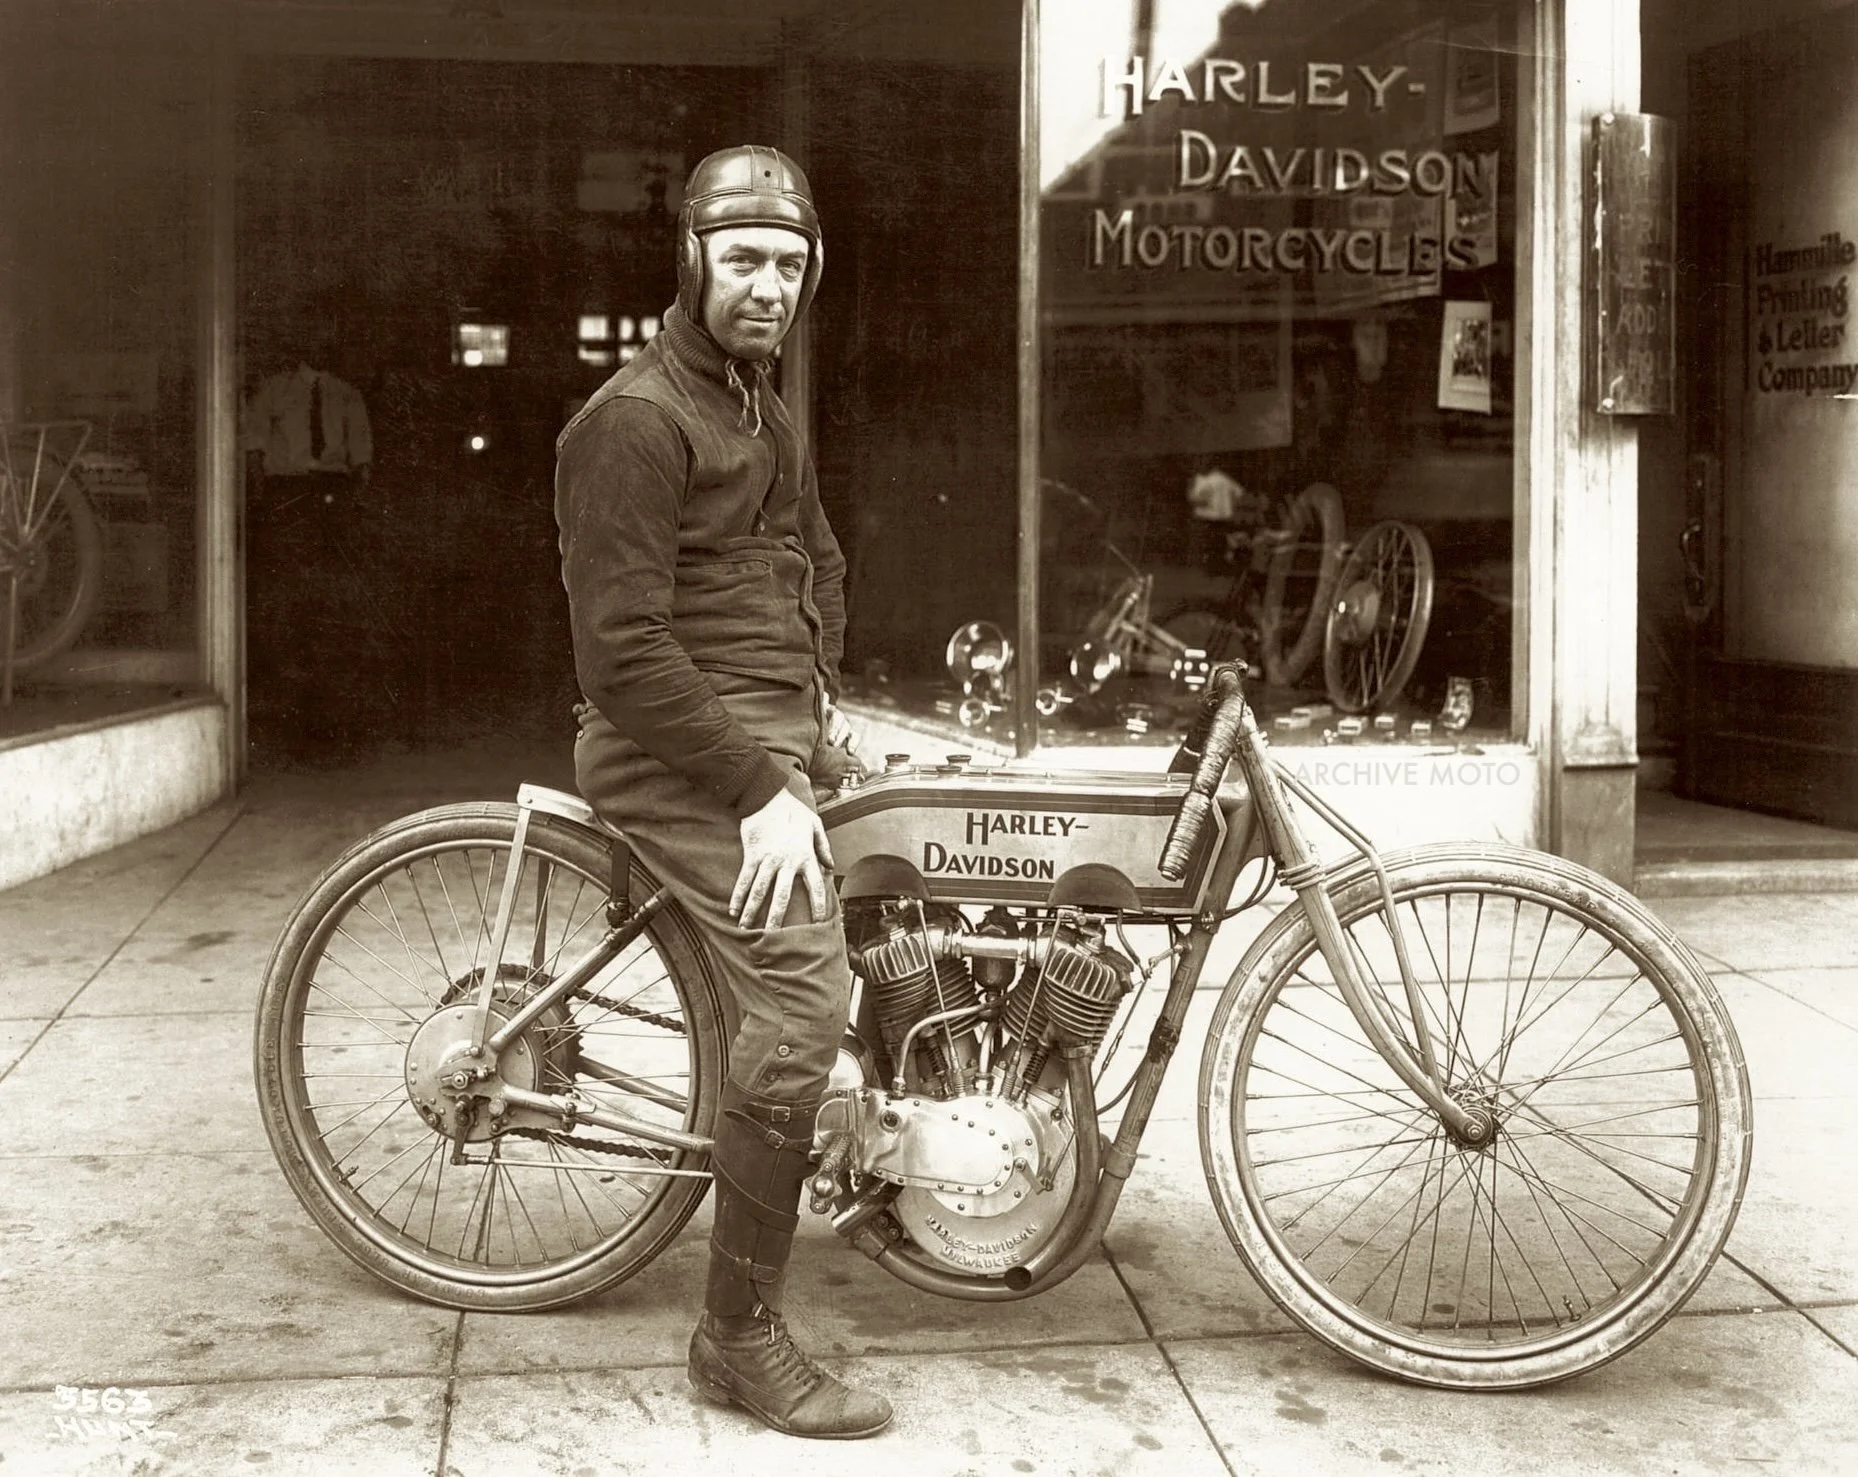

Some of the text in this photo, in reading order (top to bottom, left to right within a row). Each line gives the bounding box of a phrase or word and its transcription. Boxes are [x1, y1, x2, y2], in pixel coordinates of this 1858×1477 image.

[1099, 55, 1426, 115] HARLEY-
[1177, 129, 1498, 196] DAVIDSON
[1092, 208, 1482, 277] MOTORCYCLES
[1758, 361, 1858, 400] Company
[966, 812, 1089, 845] HARLEY-
[923, 842, 1054, 879] DAVIDSON
